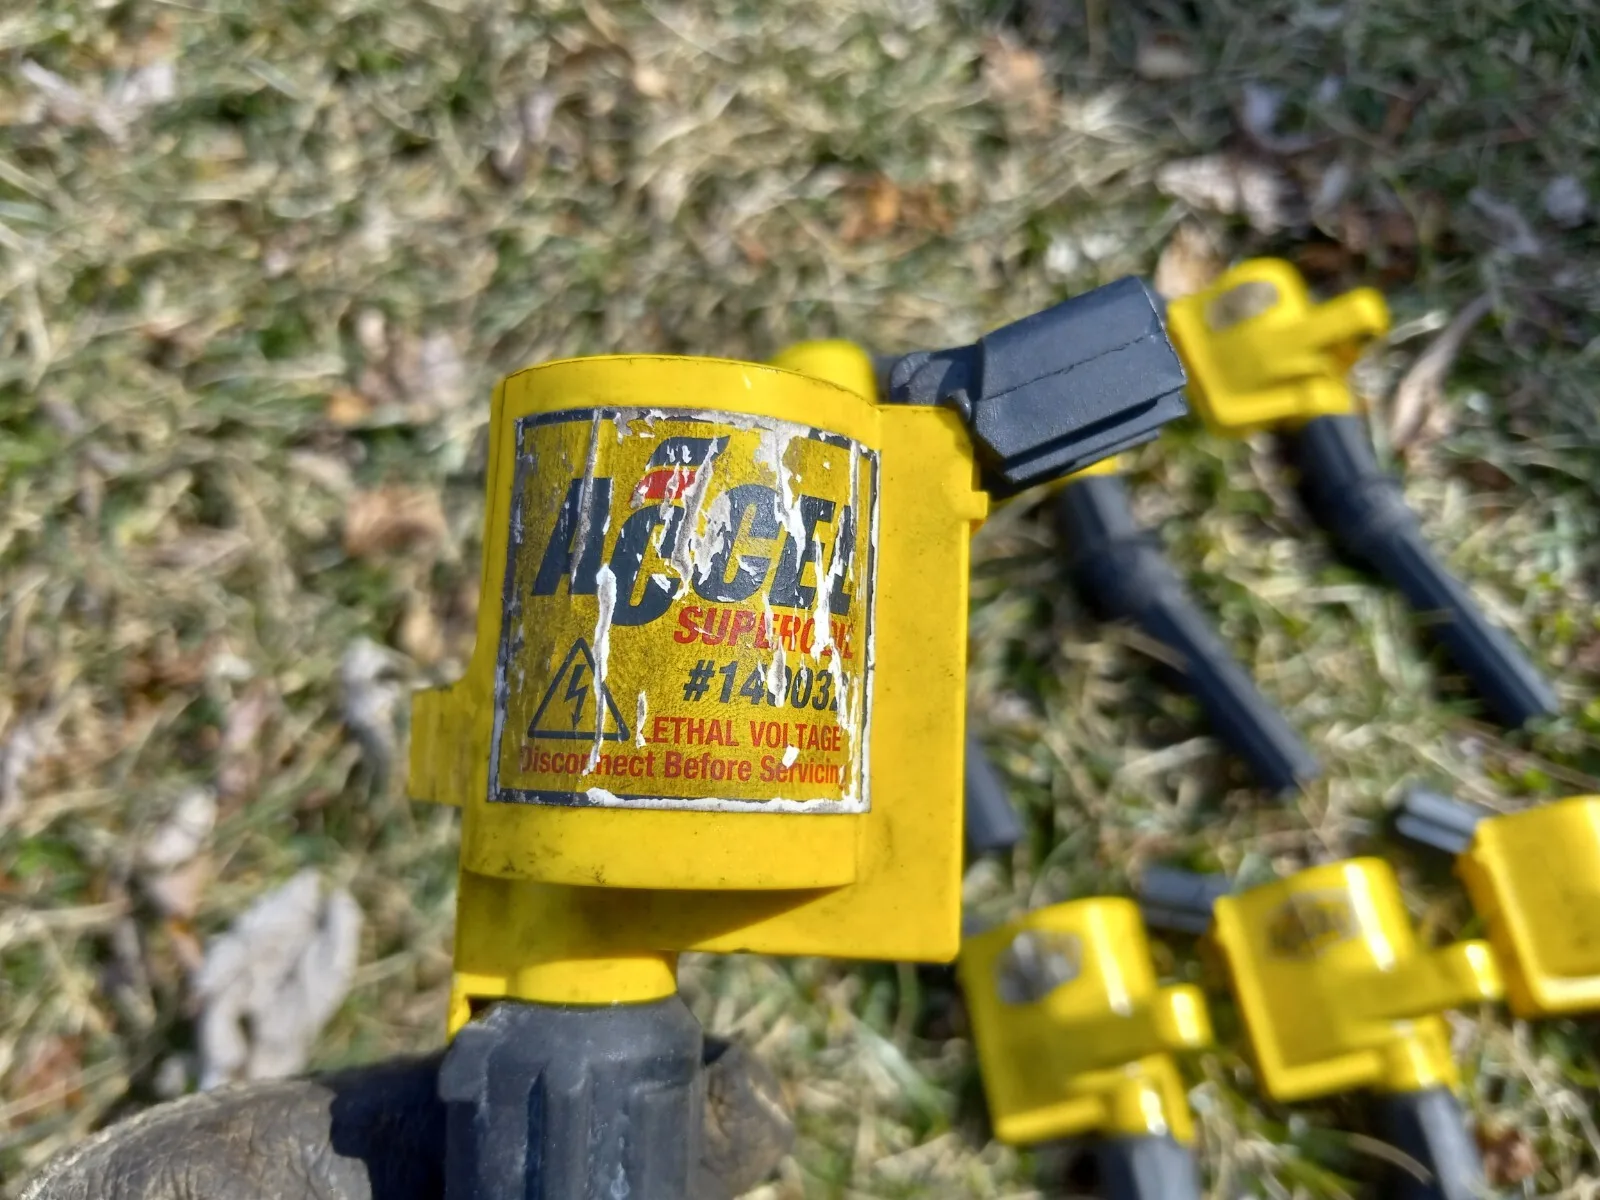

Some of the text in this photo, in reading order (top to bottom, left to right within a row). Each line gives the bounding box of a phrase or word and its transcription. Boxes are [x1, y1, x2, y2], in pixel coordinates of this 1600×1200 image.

[531, 476, 856, 627] ACCEL
[750, 720, 841, 752] VOLTAGE
[664, 750, 752, 782] Before
